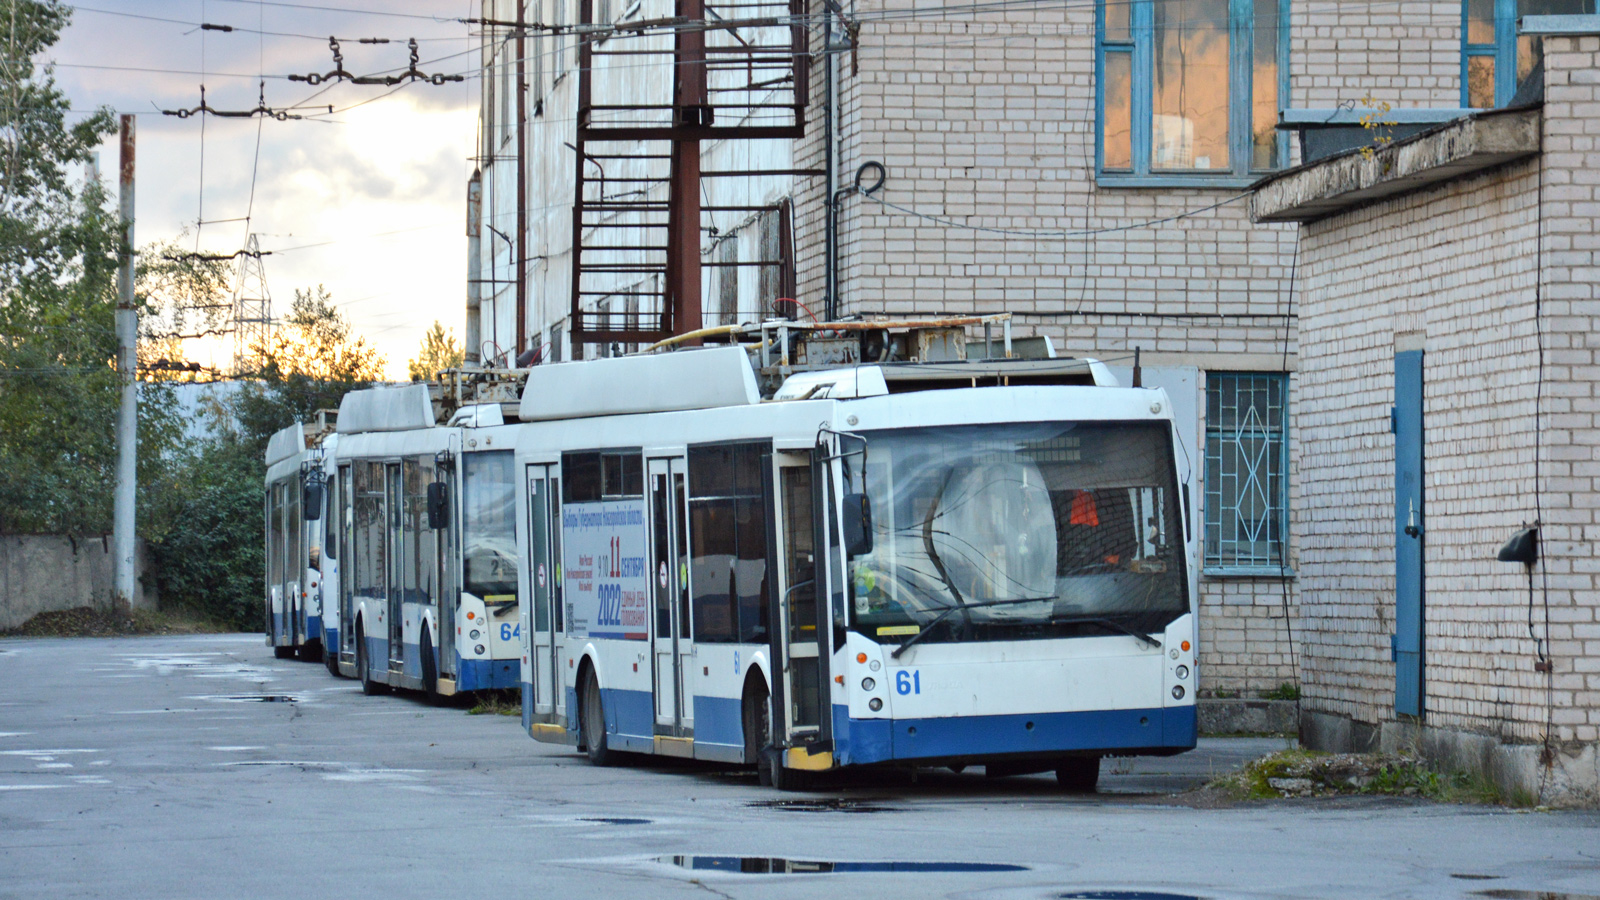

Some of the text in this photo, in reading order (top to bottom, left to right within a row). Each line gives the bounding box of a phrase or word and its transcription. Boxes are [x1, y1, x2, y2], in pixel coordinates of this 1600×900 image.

[610, 536, 620, 578] 11
[621, 556, 644, 578] СЕНТЯБРЯ
[598, 583, 621, 626] 2022
[895, 669, 921, 696] 61
